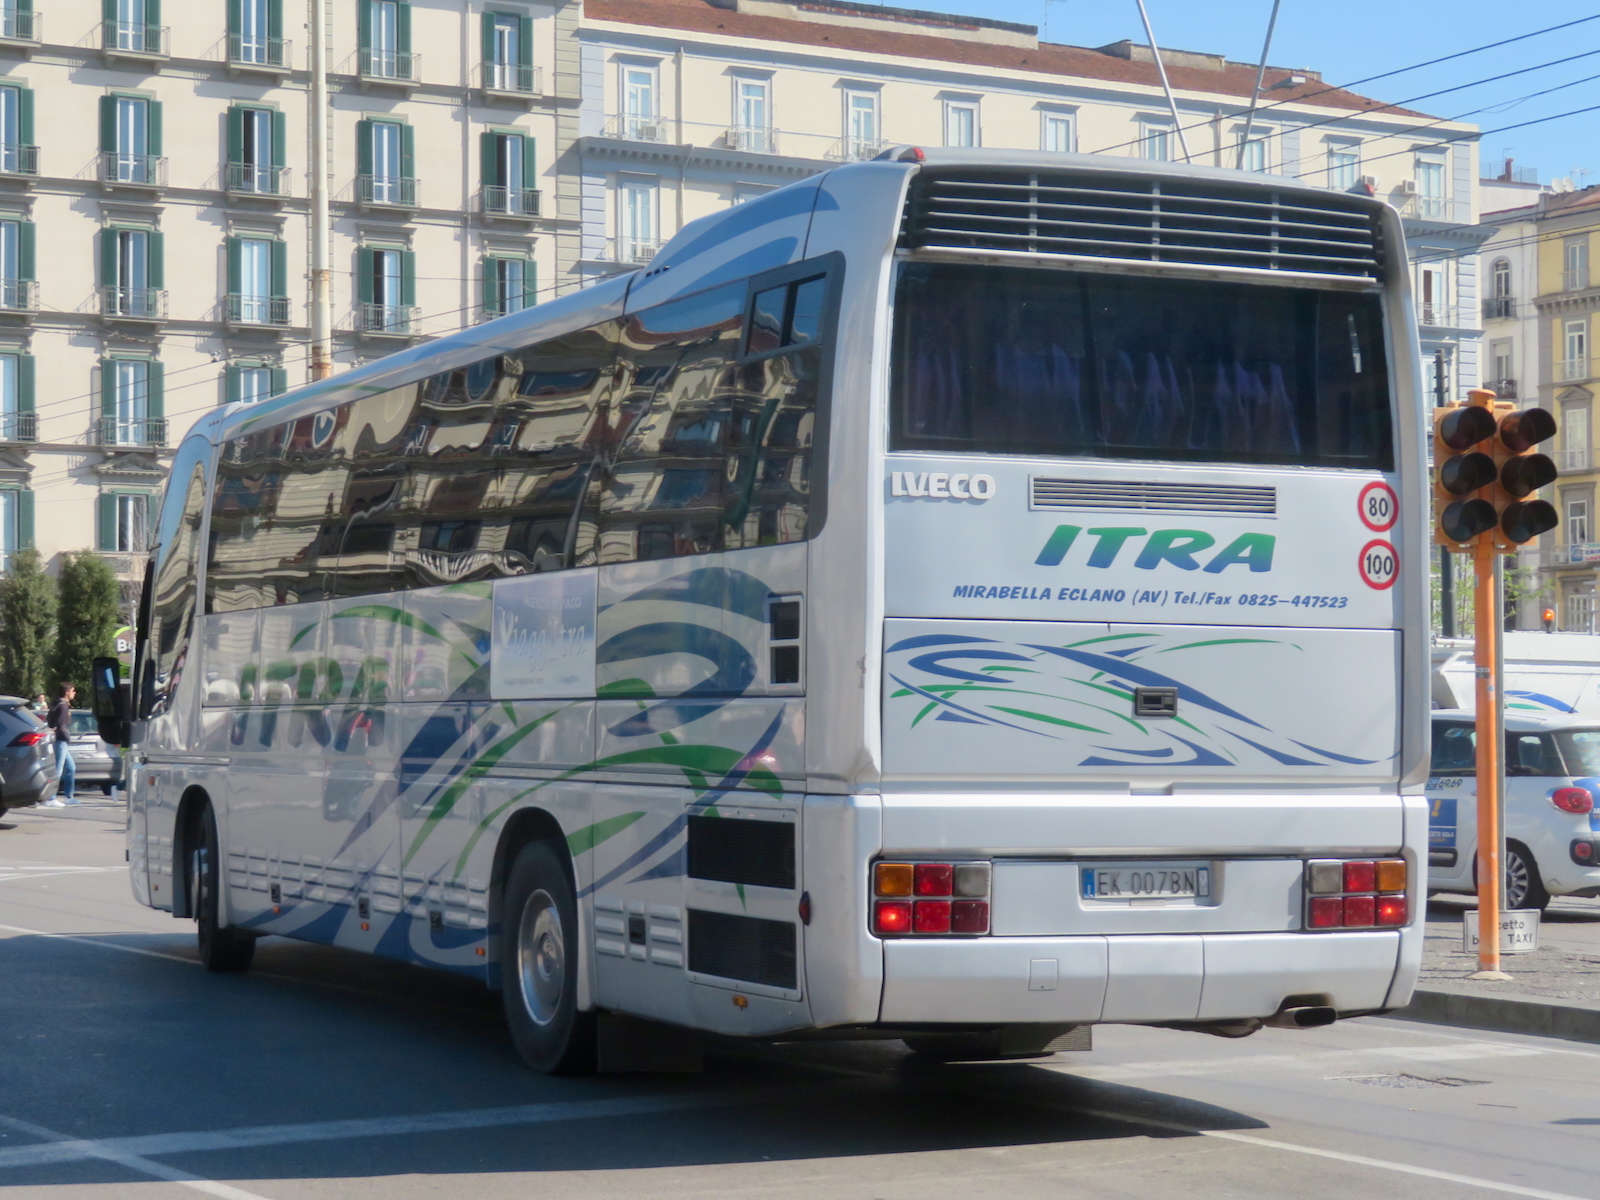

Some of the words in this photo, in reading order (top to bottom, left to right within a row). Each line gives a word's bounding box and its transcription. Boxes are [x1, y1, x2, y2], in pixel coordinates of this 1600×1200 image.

[890, 471, 997, 501] IVECO
[1369, 497, 1389, 517] 80
[1034, 524, 1277, 574] ITRA
[1366, 554, 1393, 576] 100
[953, 585, 1052, 601] MIRABELLA
[1057, 587, 1126, 603] ECLANO
[1132, 589, 1169, 606] (AV)
[1174, 591, 1232, 606] Tel./Fax
[1238, 594, 1349, 609] 0825-447523
[230, 655, 390, 752] ITRA
[1097, 872, 1122, 896] EK
[1131, 871, 1196, 895] 007BN
[1507, 933, 1533, 944] TAXI
